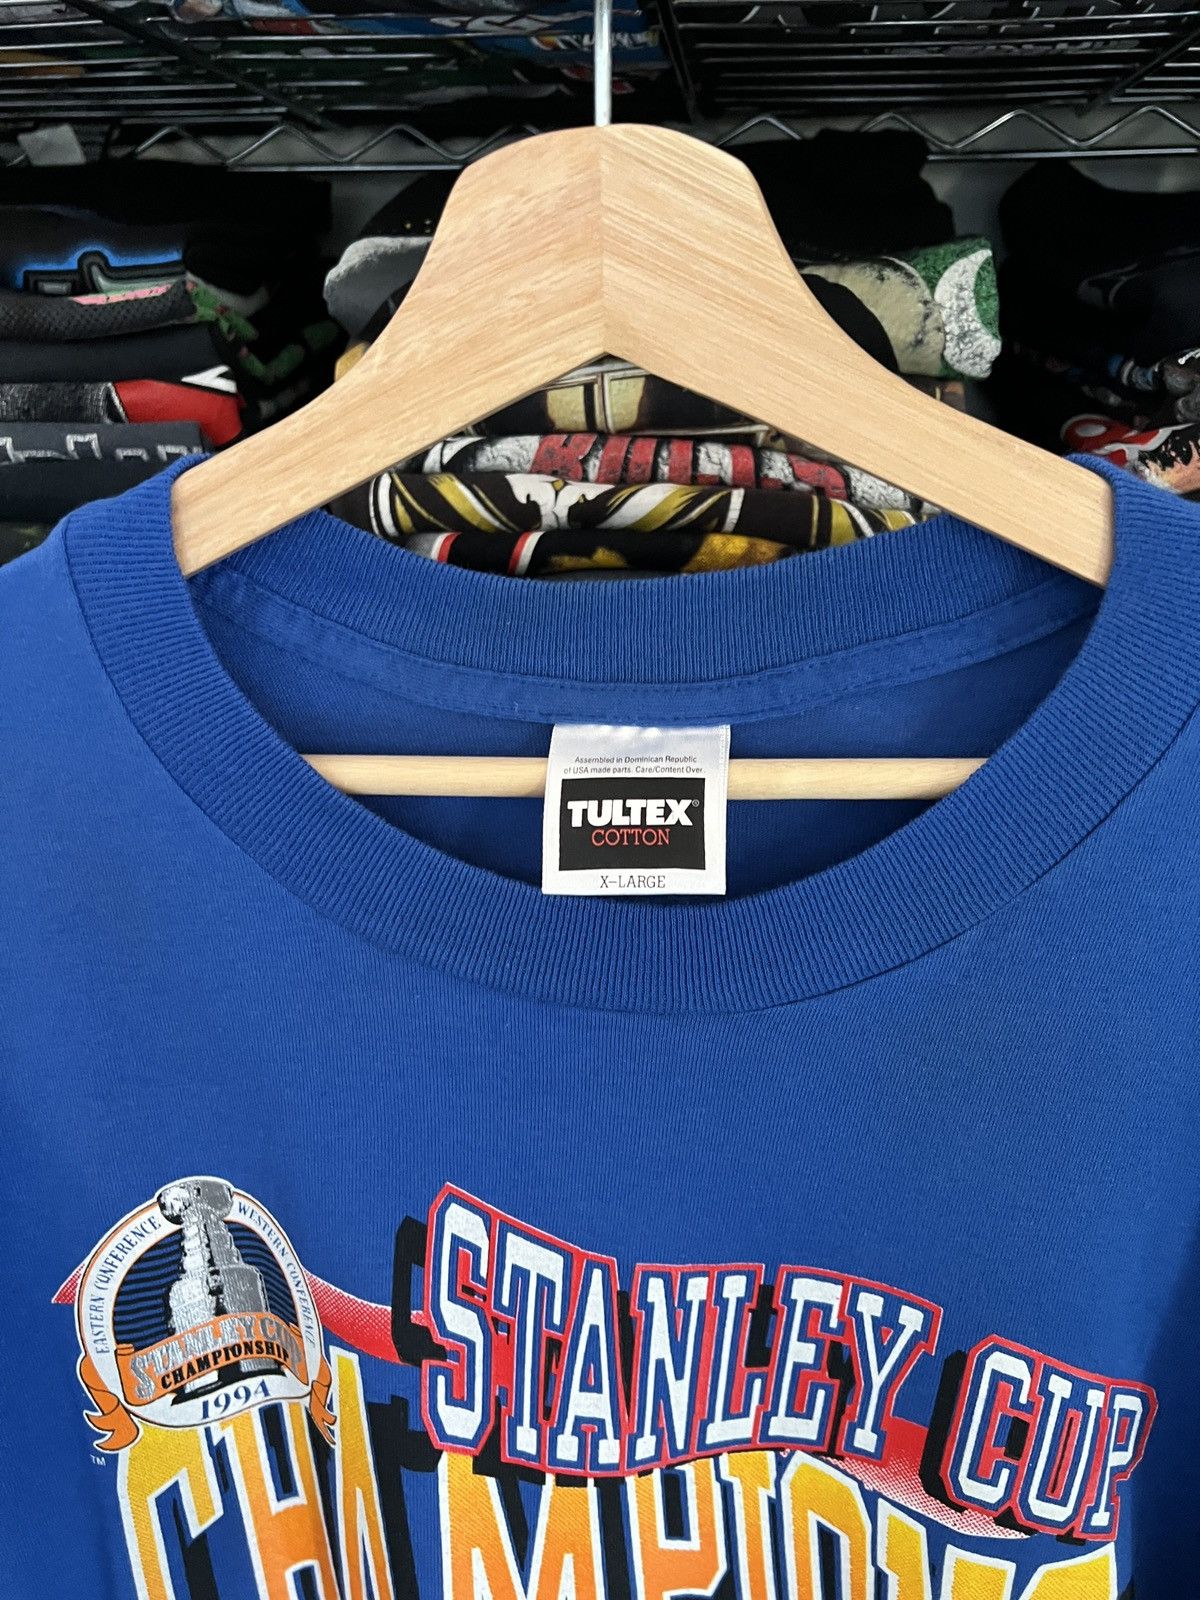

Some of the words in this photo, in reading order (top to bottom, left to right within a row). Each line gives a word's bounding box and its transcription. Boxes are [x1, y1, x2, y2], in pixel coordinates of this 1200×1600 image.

[563, 767, 571, 775] of
[572, 766, 589, 775] USA
[590, 766, 611, 775] made
[635, 766, 684, 775] Care/Content
[575, 755, 614, 764] Assembled
[616, 756, 623, 764] in
[624, 756, 664, 764] Dominican
[665, 755, 697, 765] Republic
[591, 828, 671, 847] COTTON
[600, 875, 666, 889] X-LARGE
[94, 1215, 162, 1291] CONFERENCE
[237, 1201, 289, 1258] WESTERN
[286, 1262, 316, 1349] CONFERENCE
[89, 1294, 110, 1355] EASTERN
[130, 1314, 255, 1400] STANLEY
[160, 1339, 290, 1390] CHAMPIONSHIP
[427, 1183, 944, 1477] STANLEY
[944, 1334, 1158, 1542] CUP
[201, 1378, 272, 1420] 1994
[116, 1344, 1120, 1600] CHAMPIO
